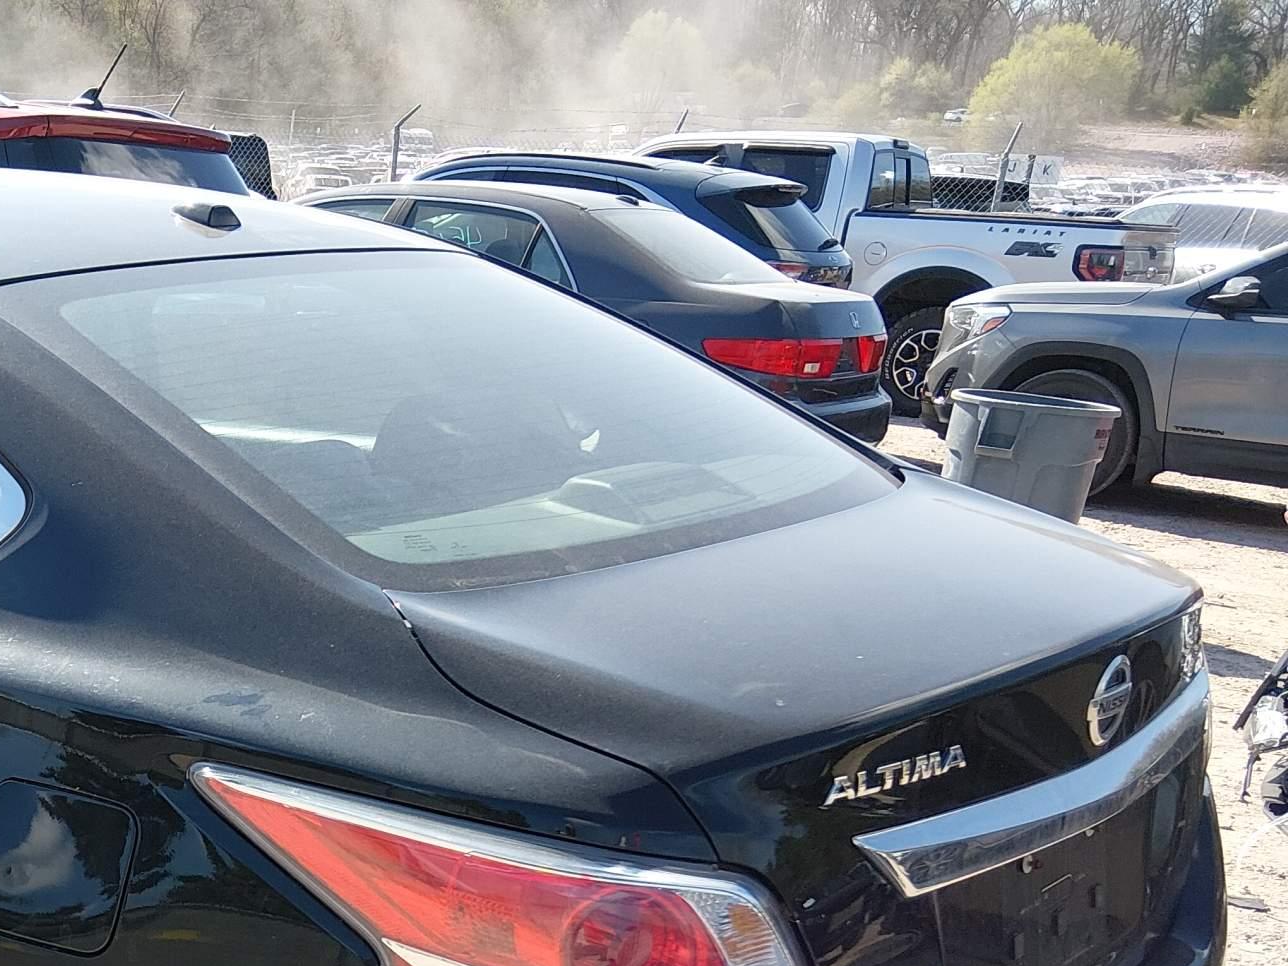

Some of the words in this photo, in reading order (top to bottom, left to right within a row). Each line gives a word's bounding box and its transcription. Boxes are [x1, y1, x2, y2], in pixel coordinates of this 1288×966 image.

[1042, 163, 1053, 176] K
[987, 226, 1067, 237] LARIAT
[822, 744, 967, 806] ALTIMA
